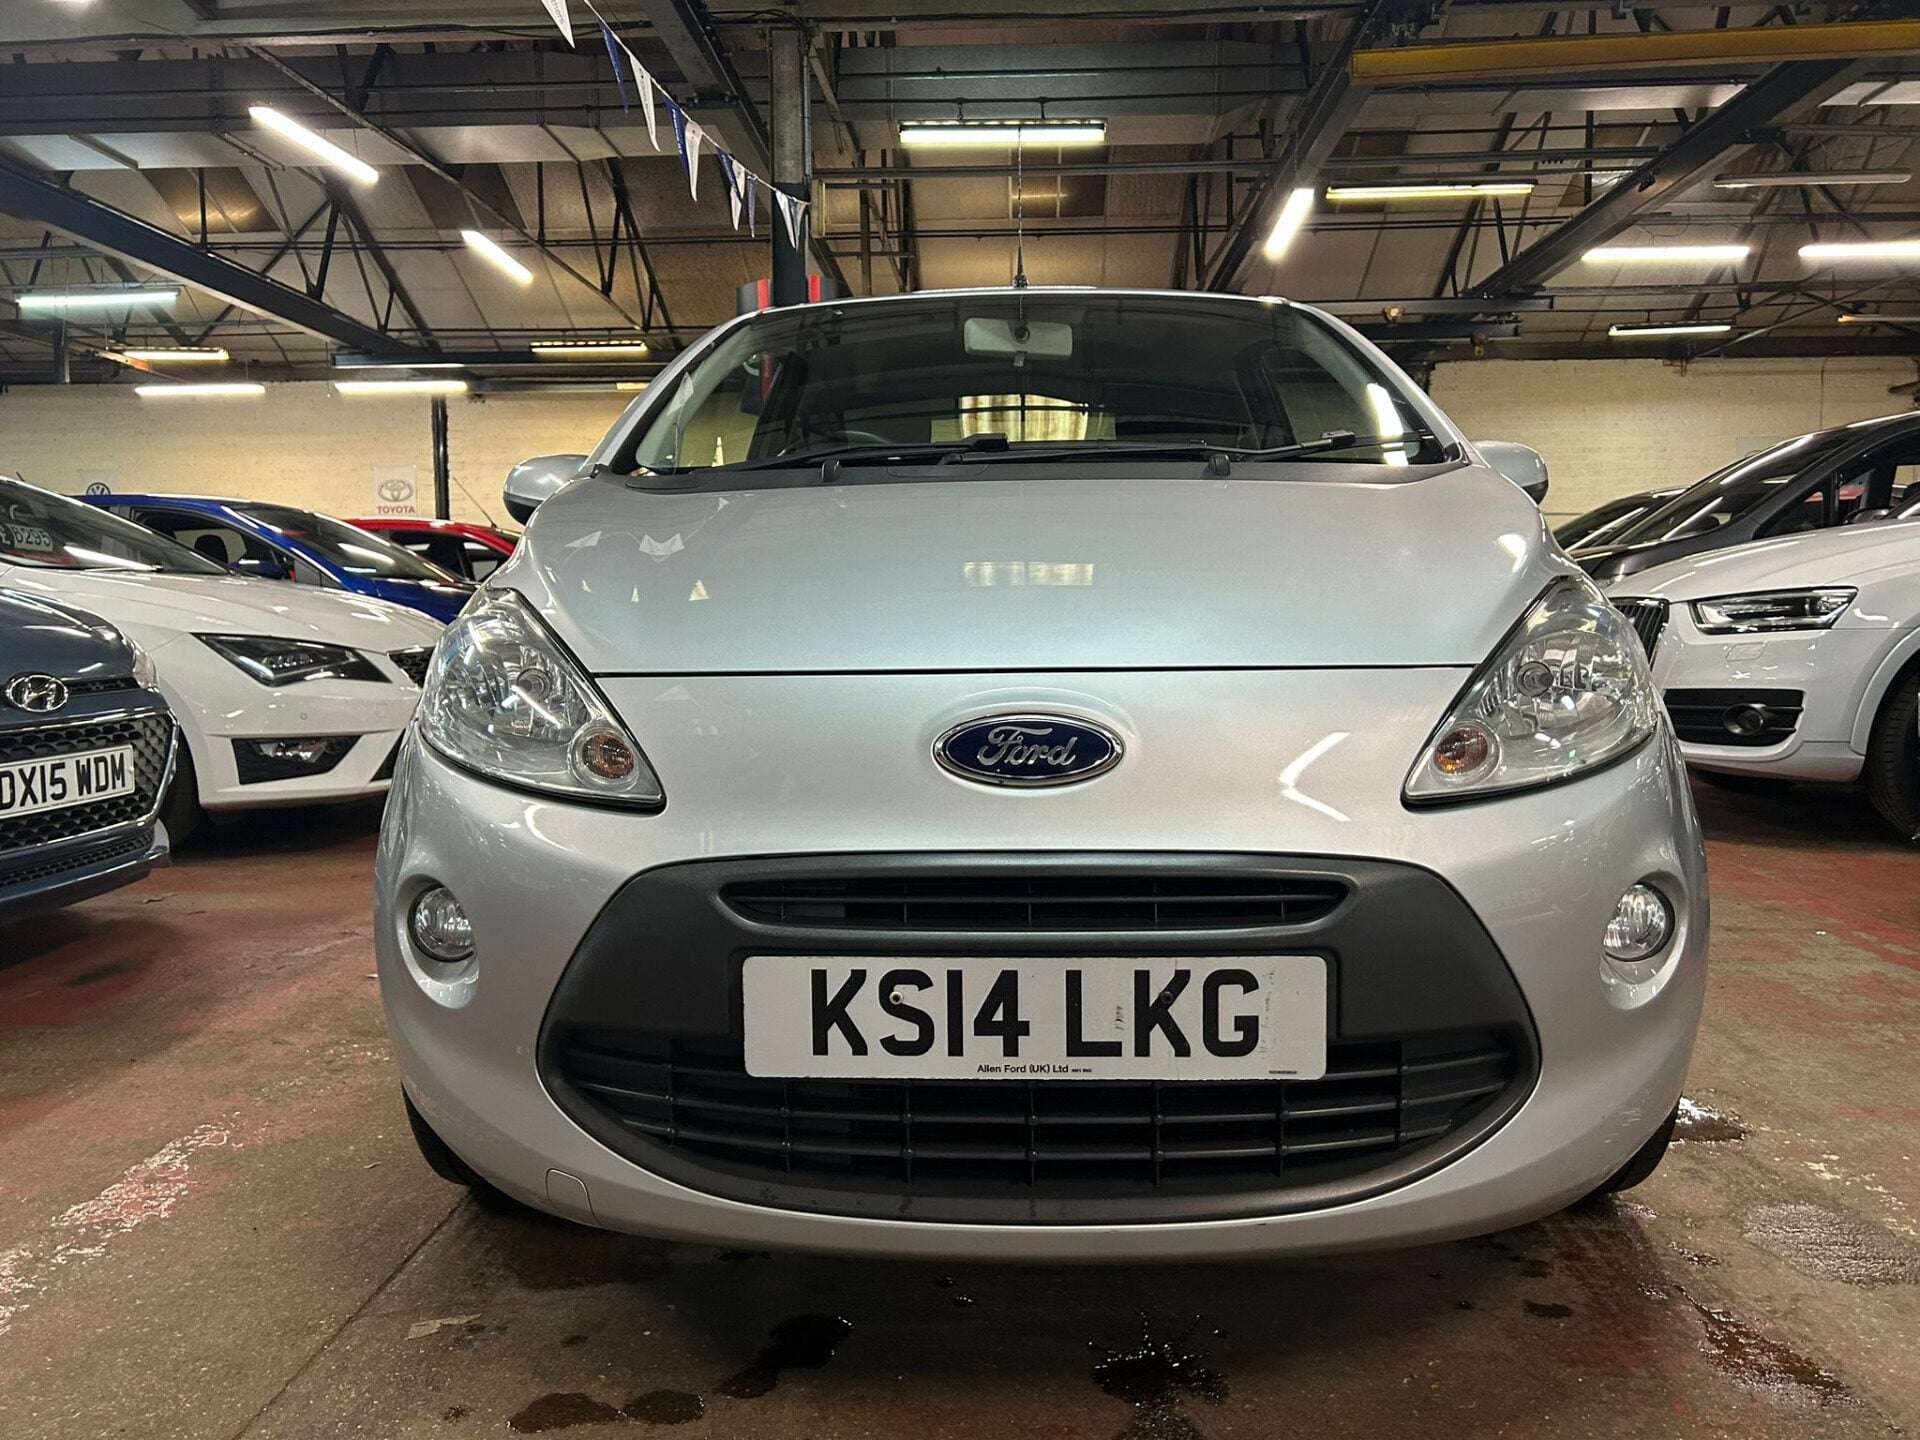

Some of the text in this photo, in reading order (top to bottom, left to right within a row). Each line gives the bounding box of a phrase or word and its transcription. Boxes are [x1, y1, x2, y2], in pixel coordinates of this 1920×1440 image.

[376, 505, 416, 514] TOYOTA
[976, 725, 1079, 766] Ford
[0, 752, 126, 810] DX15 WDM
[811, 968, 1260, 1058] KS14 LKG
[977, 1064, 1001, 1073] Allen
[1004, 1064, 1026, 1073] Ford
[1029, 1063, 1050, 1074] (UK)
[1053, 1064, 1068, 1073] Ltd
